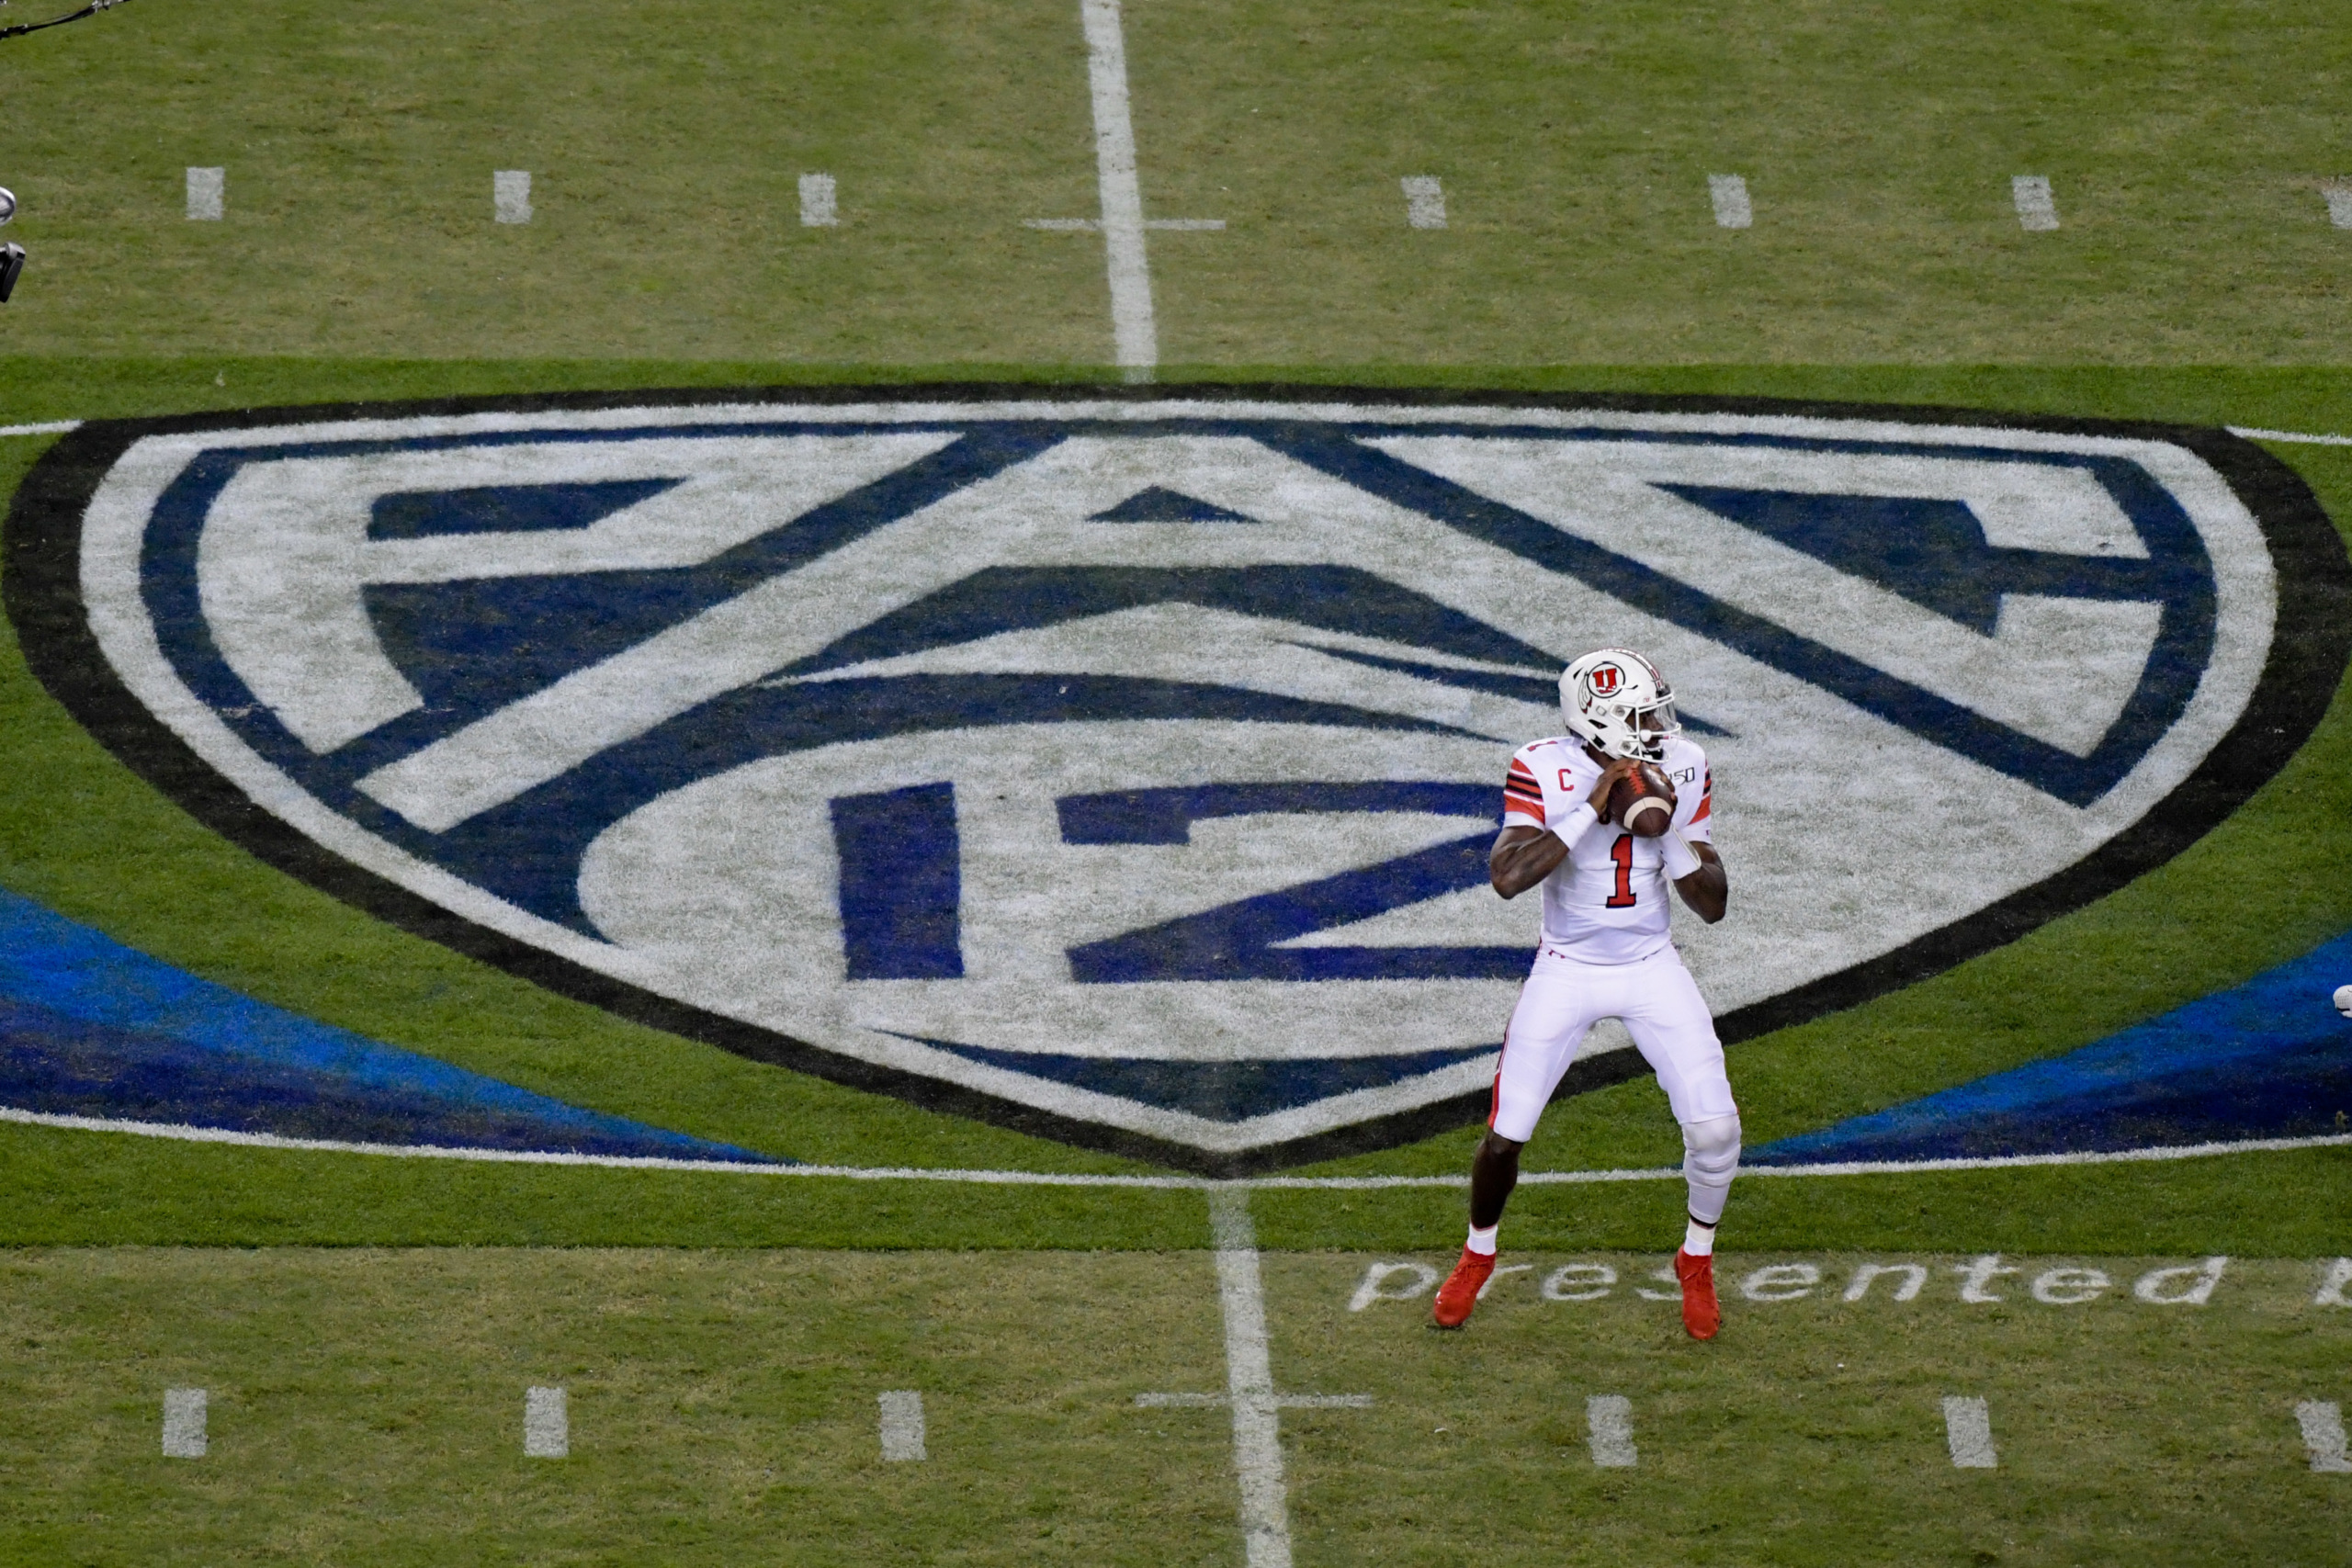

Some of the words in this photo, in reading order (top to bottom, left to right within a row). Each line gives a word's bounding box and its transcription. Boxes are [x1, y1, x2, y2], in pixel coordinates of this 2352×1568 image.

[196, 432, 2163, 835] PAC
[1592, 668, 1617, 694] U
[1558, 768, 1574, 791] C
[829, 781, 1542, 985] 12
[1605, 833, 1637, 909] 1
